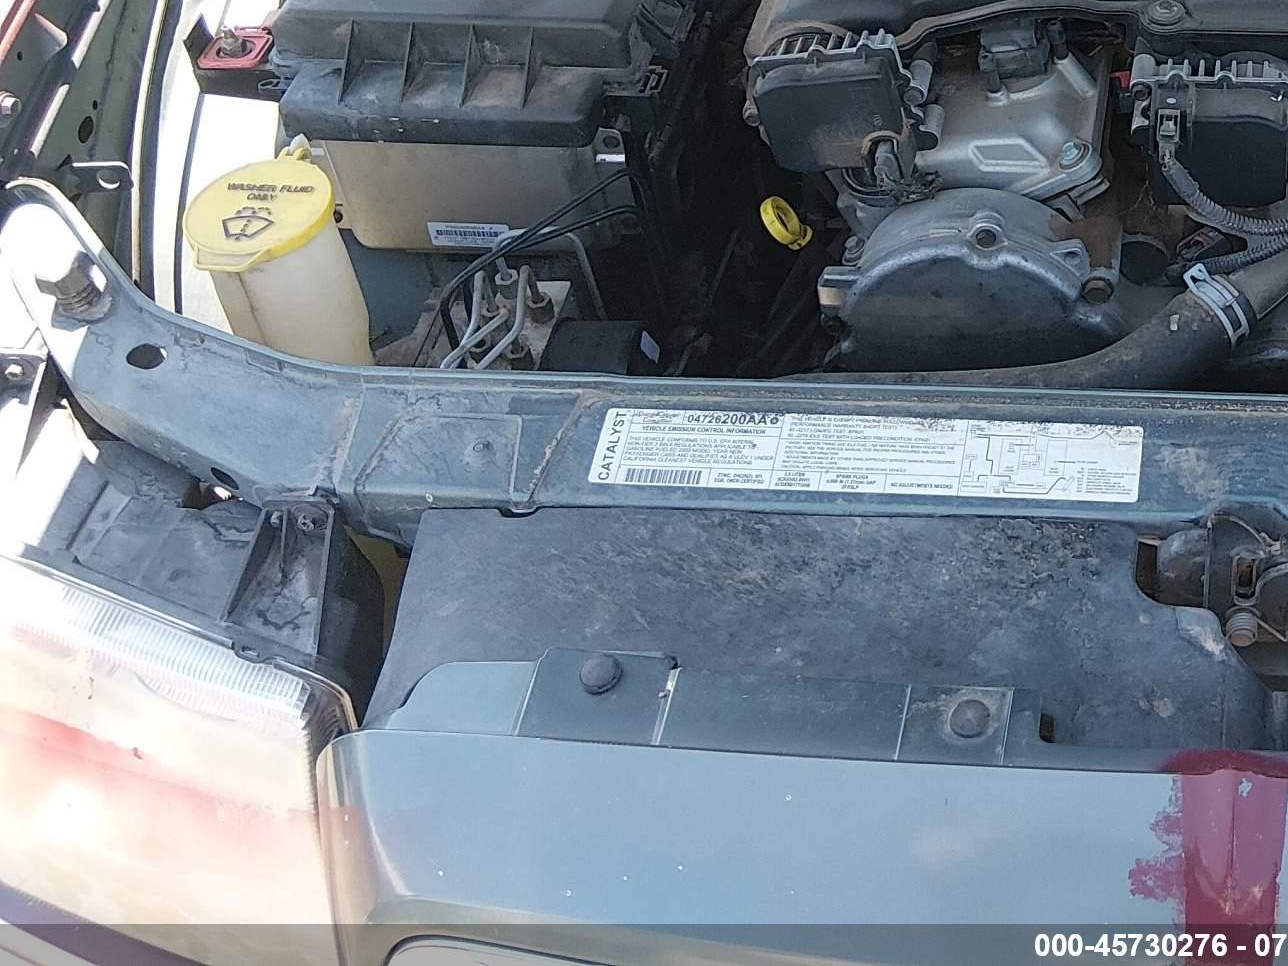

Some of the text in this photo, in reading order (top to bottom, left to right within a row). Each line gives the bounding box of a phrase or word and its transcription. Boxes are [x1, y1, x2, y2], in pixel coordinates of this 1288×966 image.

[227, 182, 315, 193] WASHER FLUID
[246, 192, 277, 202] ONLY
[725, 427, 766, 435] INFORMATION
[598, 411, 627, 481] CATALYST
